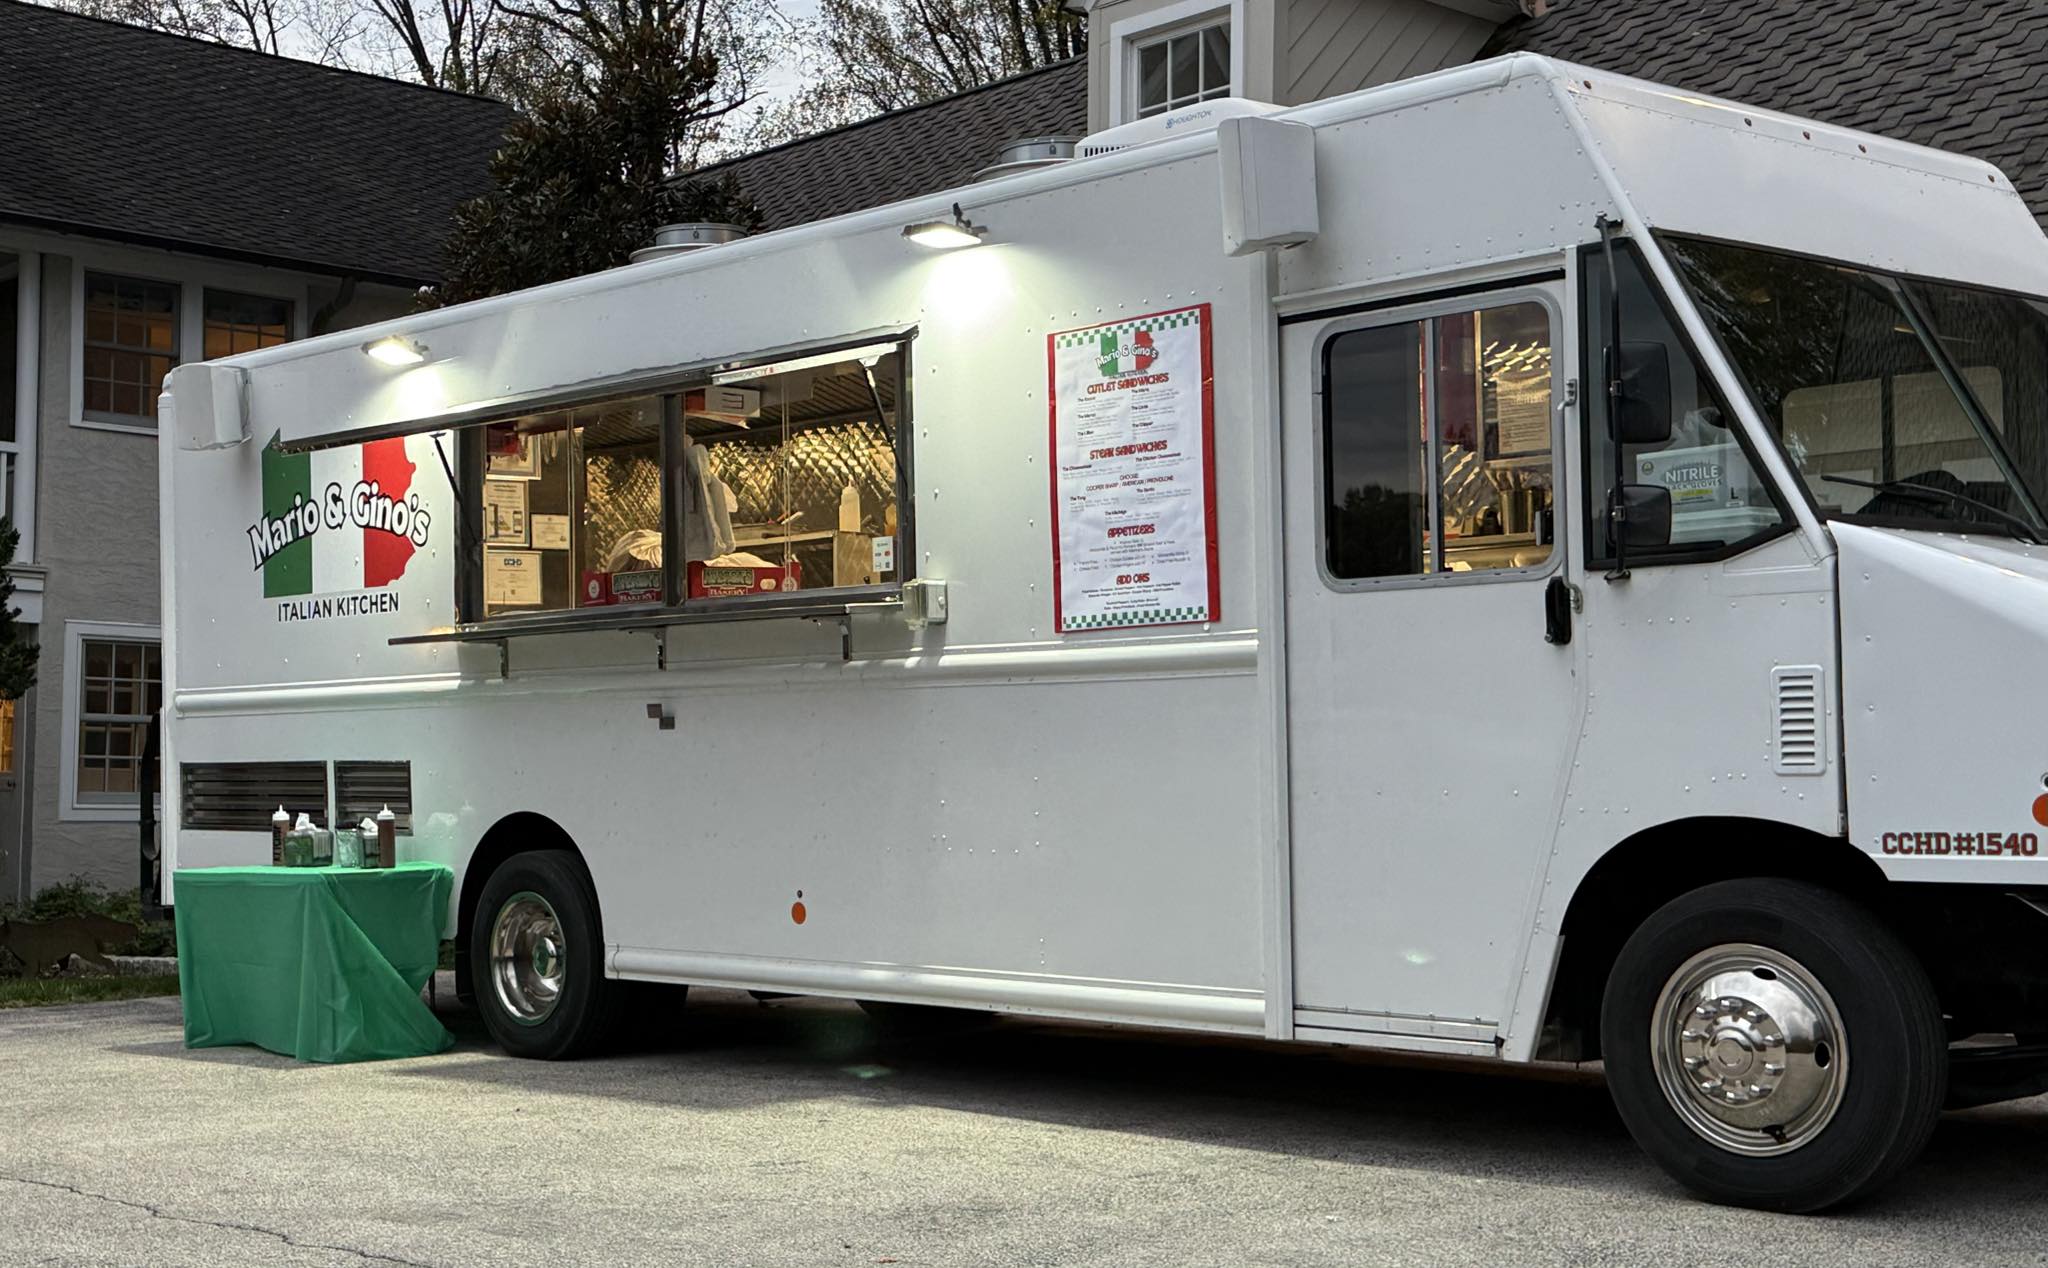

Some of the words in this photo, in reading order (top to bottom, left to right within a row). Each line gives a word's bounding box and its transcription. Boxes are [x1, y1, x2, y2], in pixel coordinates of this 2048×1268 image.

[1095, 348, 1121, 369] Mario
[1121, 344, 1130, 357] &
[1131, 343, 1159, 360] Gino's
[1087, 381, 1116, 394] CUTLET
[1117, 373, 1169, 390] SANDWICHES
[1090, 448, 1115, 460] STEAK
[1116, 440, 1168, 456] SANDWICHES
[1665, 465, 1719, 482] NITRILE
[1730, 487, 1739, 499] L
[247, 492, 321, 572] Mario
[324, 482, 347, 530] &
[350, 479, 431, 547] Gino's
[1107, 524, 1155, 538] APPETIZERS
[1116, 575, 1132, 585] ADD
[1132, 572, 1151, 583] ONS
[278, 599, 332, 622] ITALIAN
[336, 592, 399, 616] KITCHEN
[1882, 832, 2038, 857] CCHD#1540
